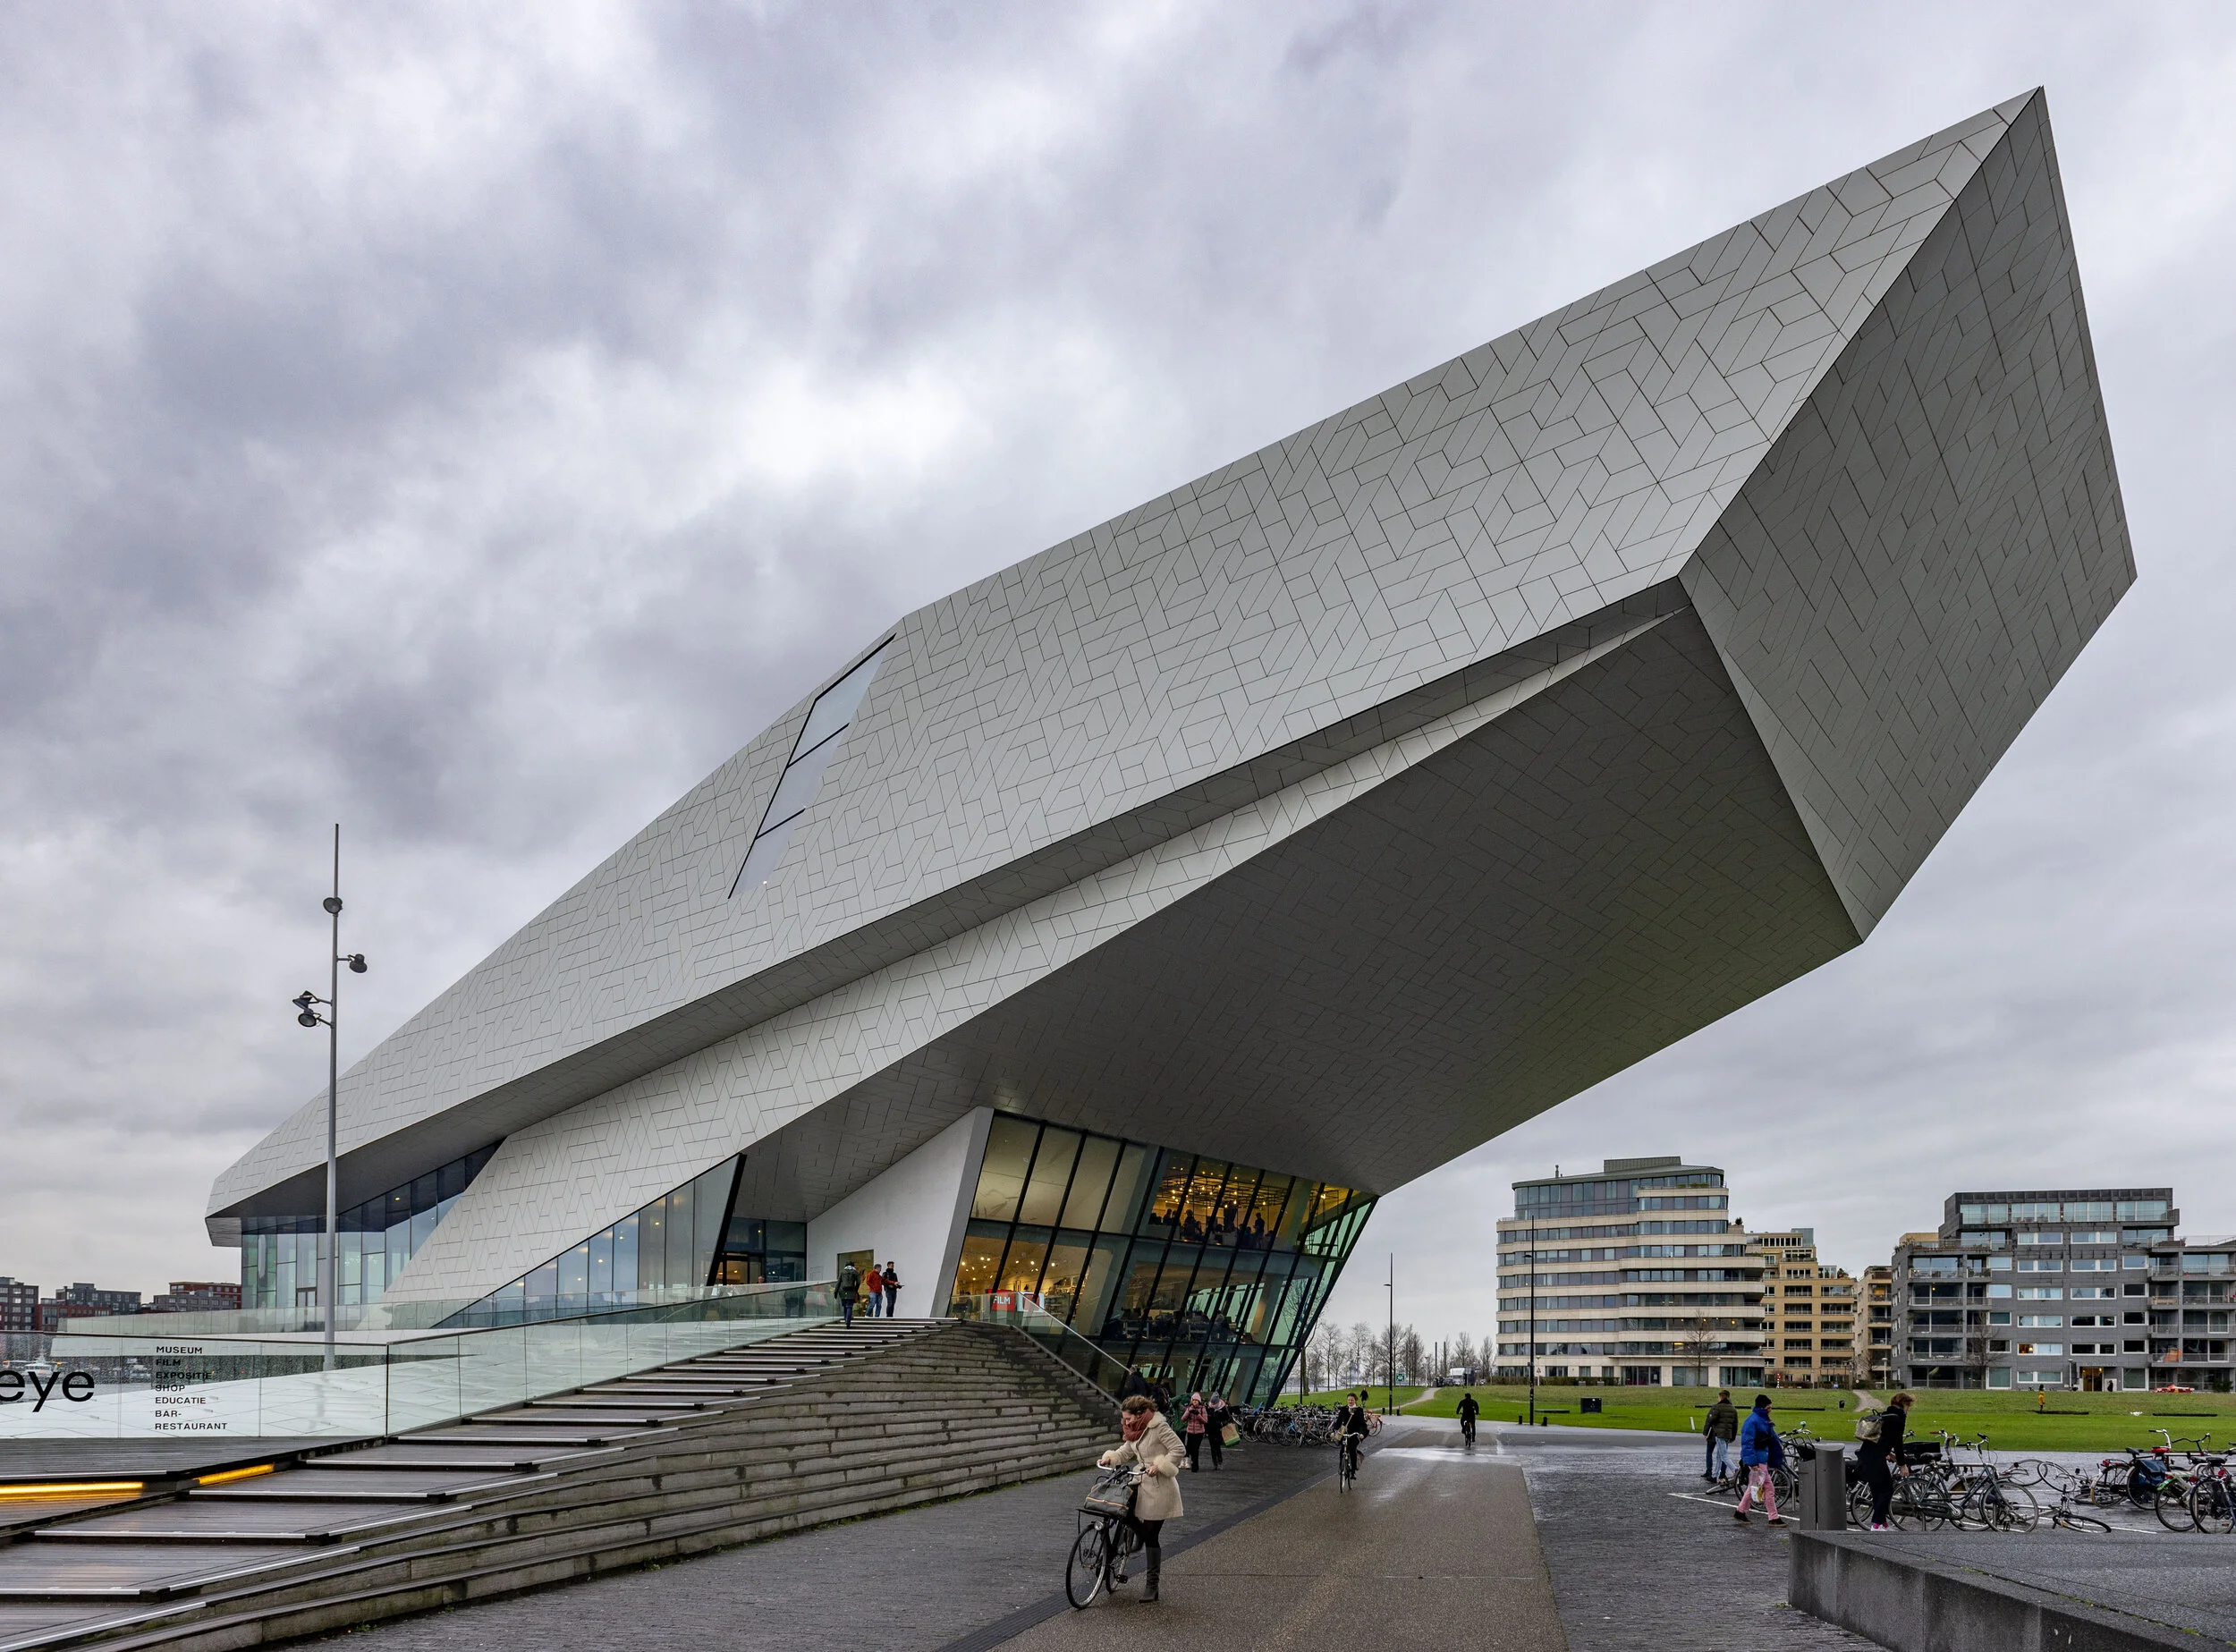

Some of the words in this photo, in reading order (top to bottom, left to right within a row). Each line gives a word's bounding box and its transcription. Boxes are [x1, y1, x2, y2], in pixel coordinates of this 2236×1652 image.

[156, 1346, 203, 1354] MUSEUM
[156, 1359, 182, 1367] FILM
[156, 1371, 212, 1380] EXPOSITIE
[0, 1369, 95, 1413] eye
[155, 1384, 185, 1392] SHOP
[155, 1396, 207, 1404] EDUCATIE
[155, 1410, 182, 1418] BAR-
[155, 1422, 228, 1430] RESTAURANT
